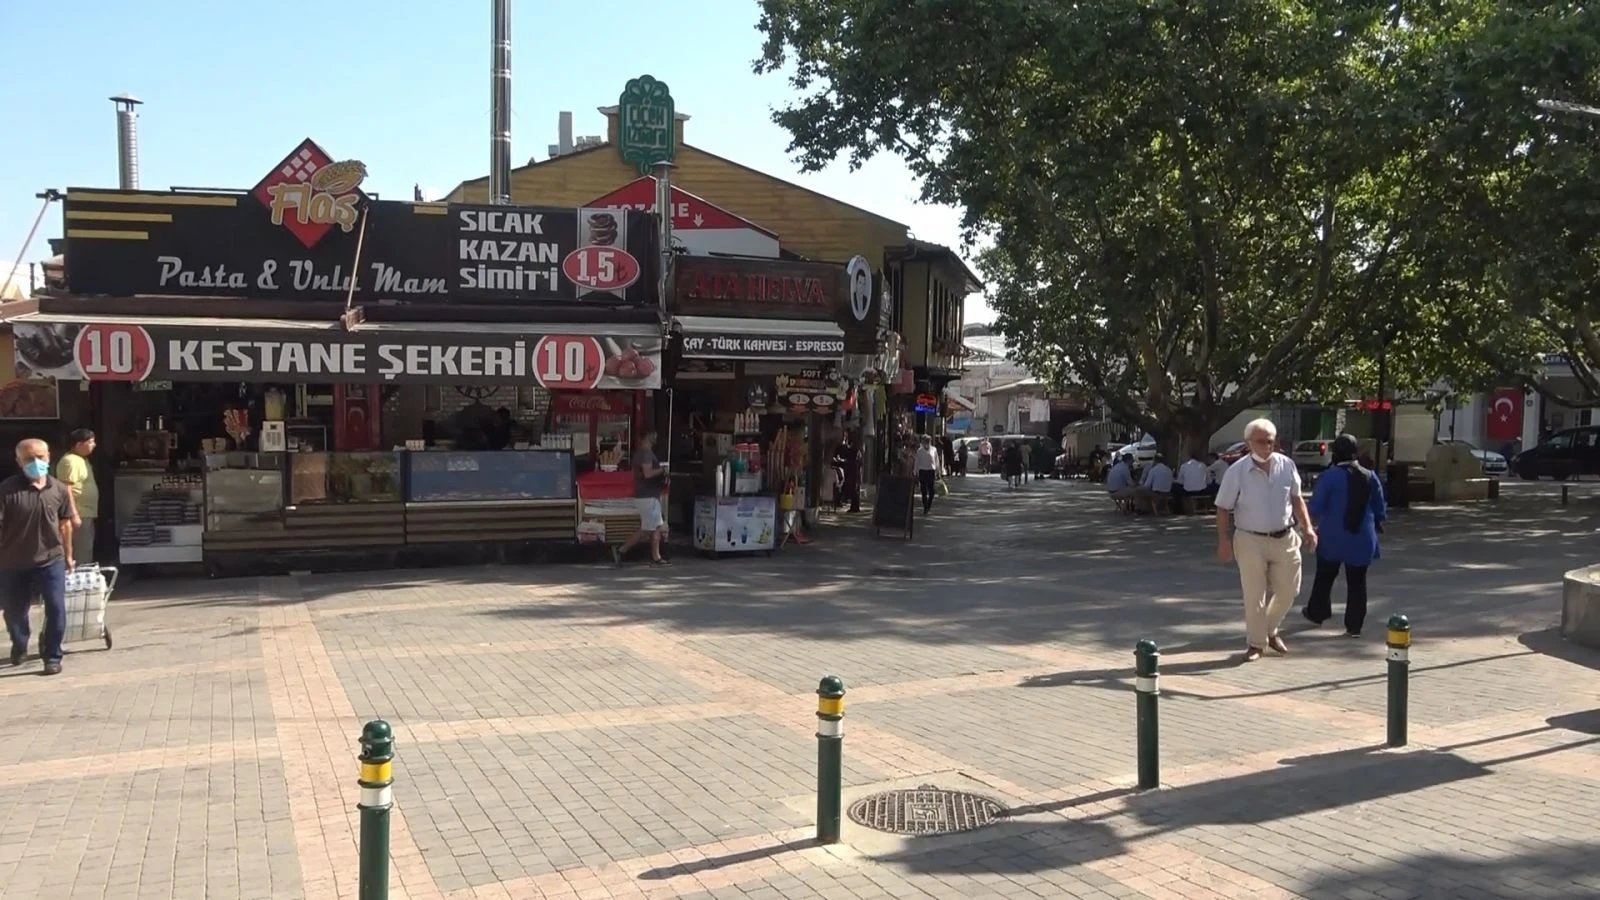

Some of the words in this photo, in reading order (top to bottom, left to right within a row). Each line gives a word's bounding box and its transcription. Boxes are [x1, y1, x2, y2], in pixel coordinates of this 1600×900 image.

[267, 182, 359, 233] Flaş
[460, 211, 543, 234] SICAK
[460, 239, 558, 263] KAZAN
[158, 256, 248, 288] Pasta
[257, 260, 279, 290] &
[371, 262, 448, 293] Mam
[744, 272, 825, 303] HELVA
[169, 340, 366, 374] KESTANE
[378, 340, 526, 380] ŞEKERİ
[683, 337, 704, 351] ÇAY
[796, 341, 844, 352] ESPRESSO
